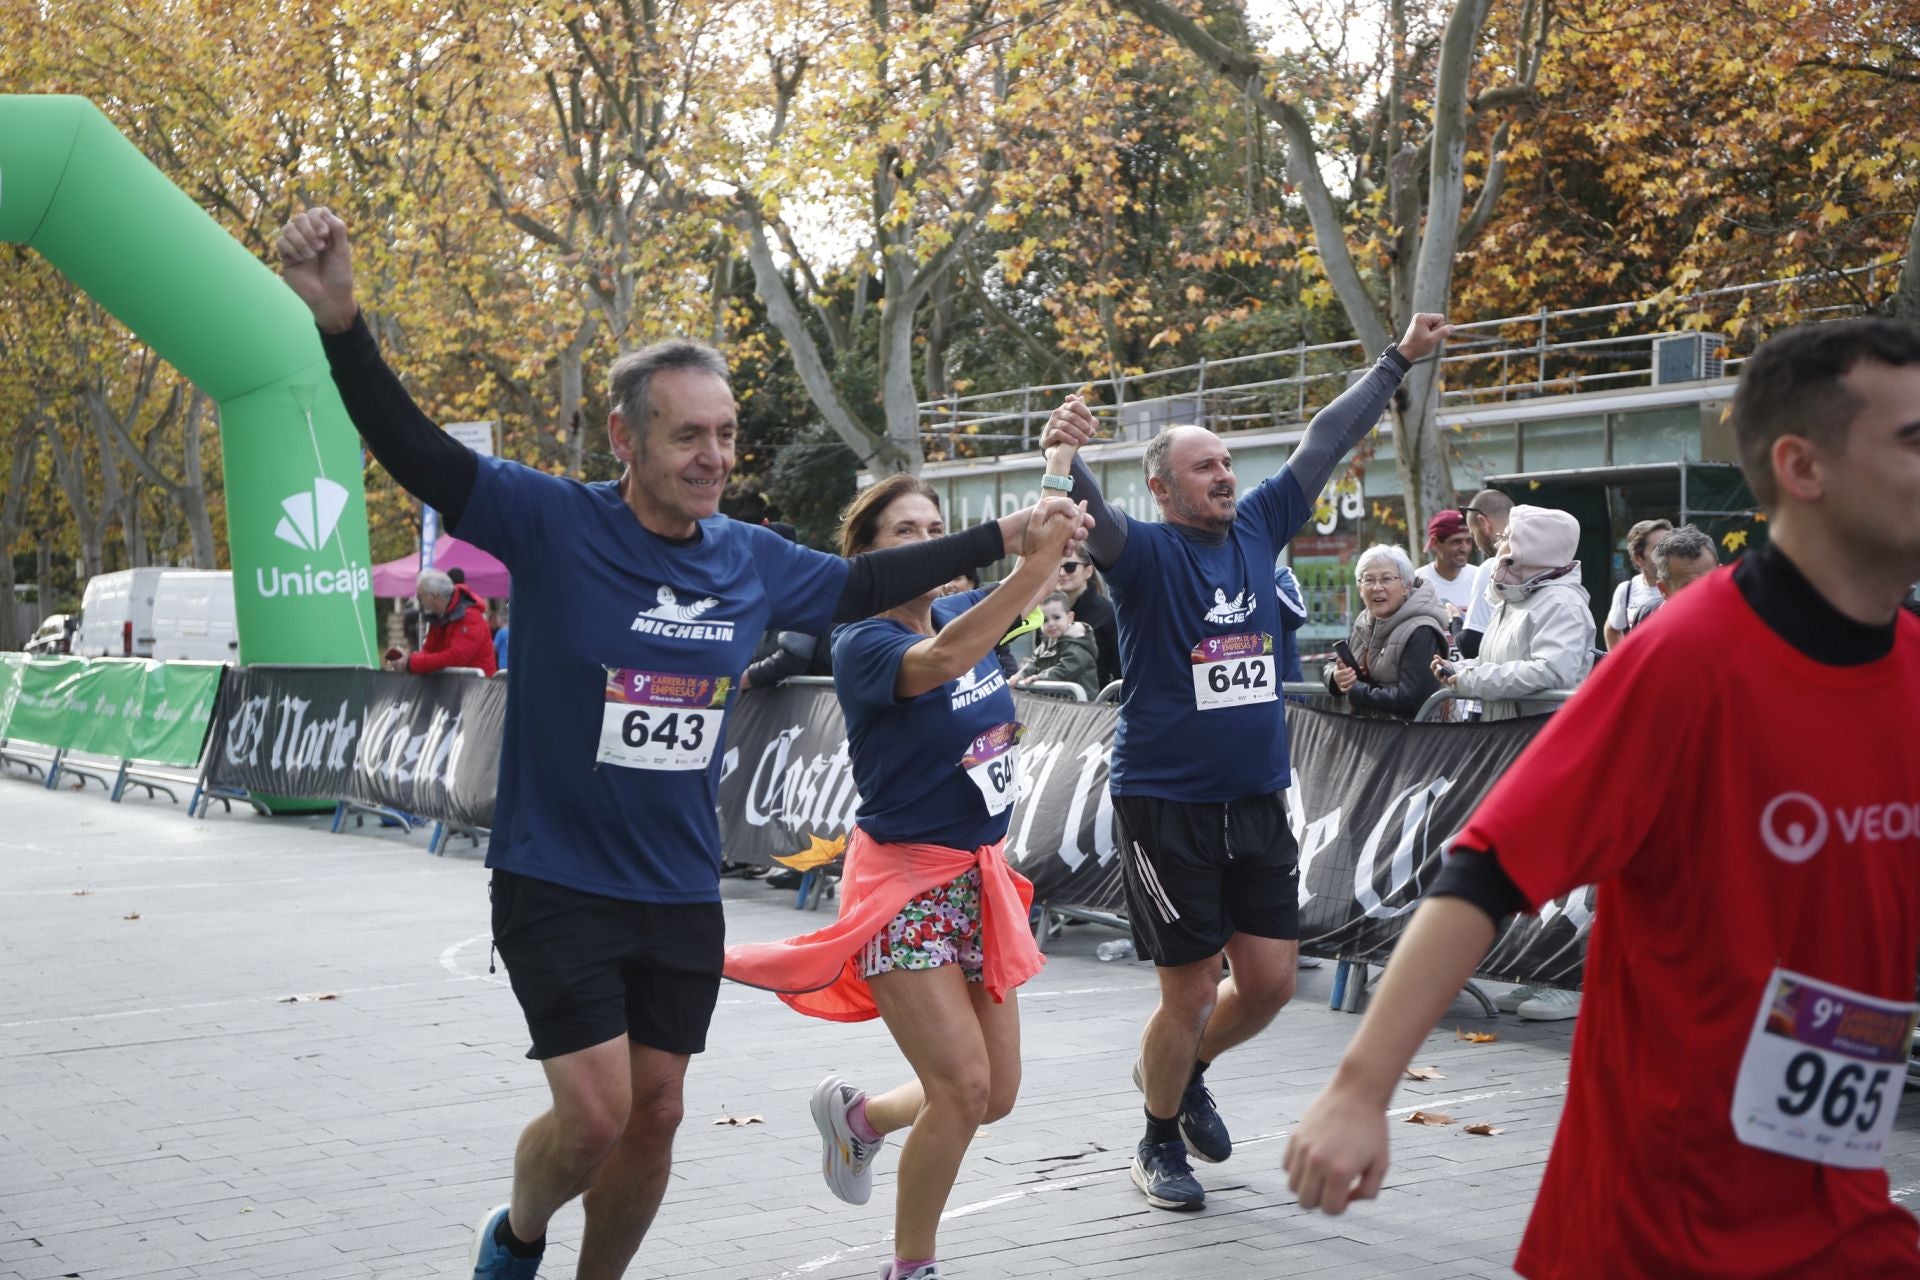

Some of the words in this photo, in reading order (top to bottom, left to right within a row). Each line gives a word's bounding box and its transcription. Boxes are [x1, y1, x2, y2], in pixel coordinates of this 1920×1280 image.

[256, 561, 369, 600] Unicaja
[630, 617, 735, 641] MICHELIN
[650, 684, 696, 697] EMPRESAS
[652, 675, 686, 687] CARRERA
[687, 678, 697, 687] DE
[951, 674, 1005, 711] MICHELIN
[1208, 660, 1267, 693] 642
[621, 710, 705, 750] 643
[987, 754, 1014, 794] 64
[1776, 1052, 1892, 1132] 965
